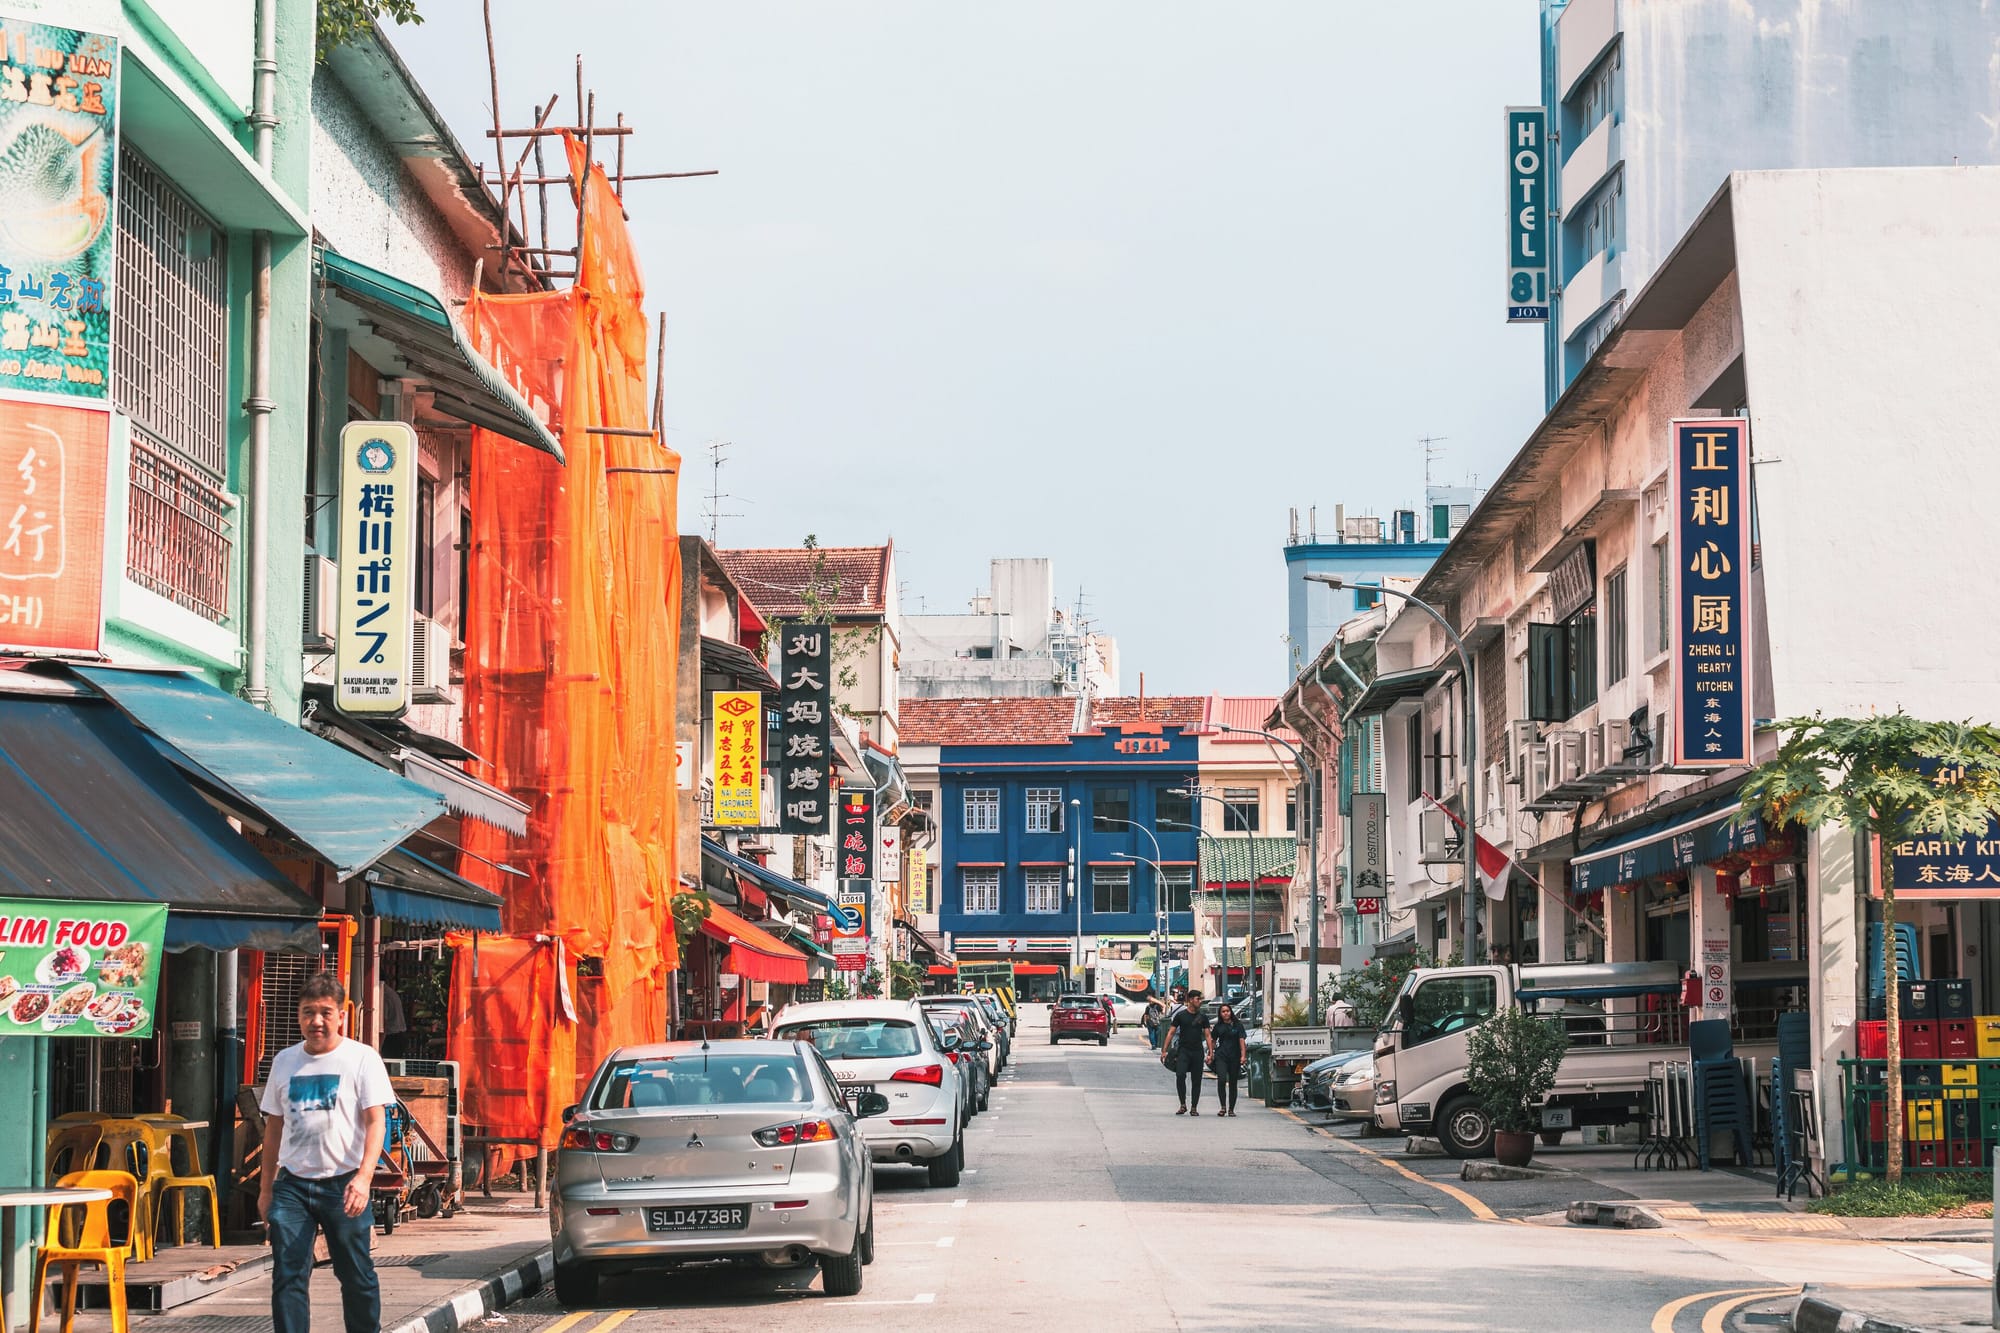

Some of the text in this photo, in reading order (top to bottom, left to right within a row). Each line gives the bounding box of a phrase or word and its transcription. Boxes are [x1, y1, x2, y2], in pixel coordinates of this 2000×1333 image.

[69, 53, 111, 79] LIAN
[1515, 122, 1540, 257] HOTEL
[1510, 271, 1546, 303] 81
[1515, 308, 1540, 317] JOY
[1690, 432, 1732, 635] 正利心厨
[355, 484, 394, 664] 桜川ポンプ
[1689, 644, 1735, 656] ZHENG LI
[1697, 662, 1732, 673] HEARTY
[1696, 681, 1734, 692] KITCHEN
[786, 633, 824, 824] 刘大妈烧烤吧
[1704, 698, 1722, 753] 东海人家
[719, 720, 735, 786] 耐志五金
[740, 719, 755, 787] 貿易公司
[1125, 741, 1159, 752] 1941
[720, 799, 753, 808] HARDWARE
[1915, 863, 2000, 884] 东海人
[1358, 898, 1377, 910] 23
[54, 920, 128, 947] FOOD
[653, 1209, 742, 1226] SLD4738R
